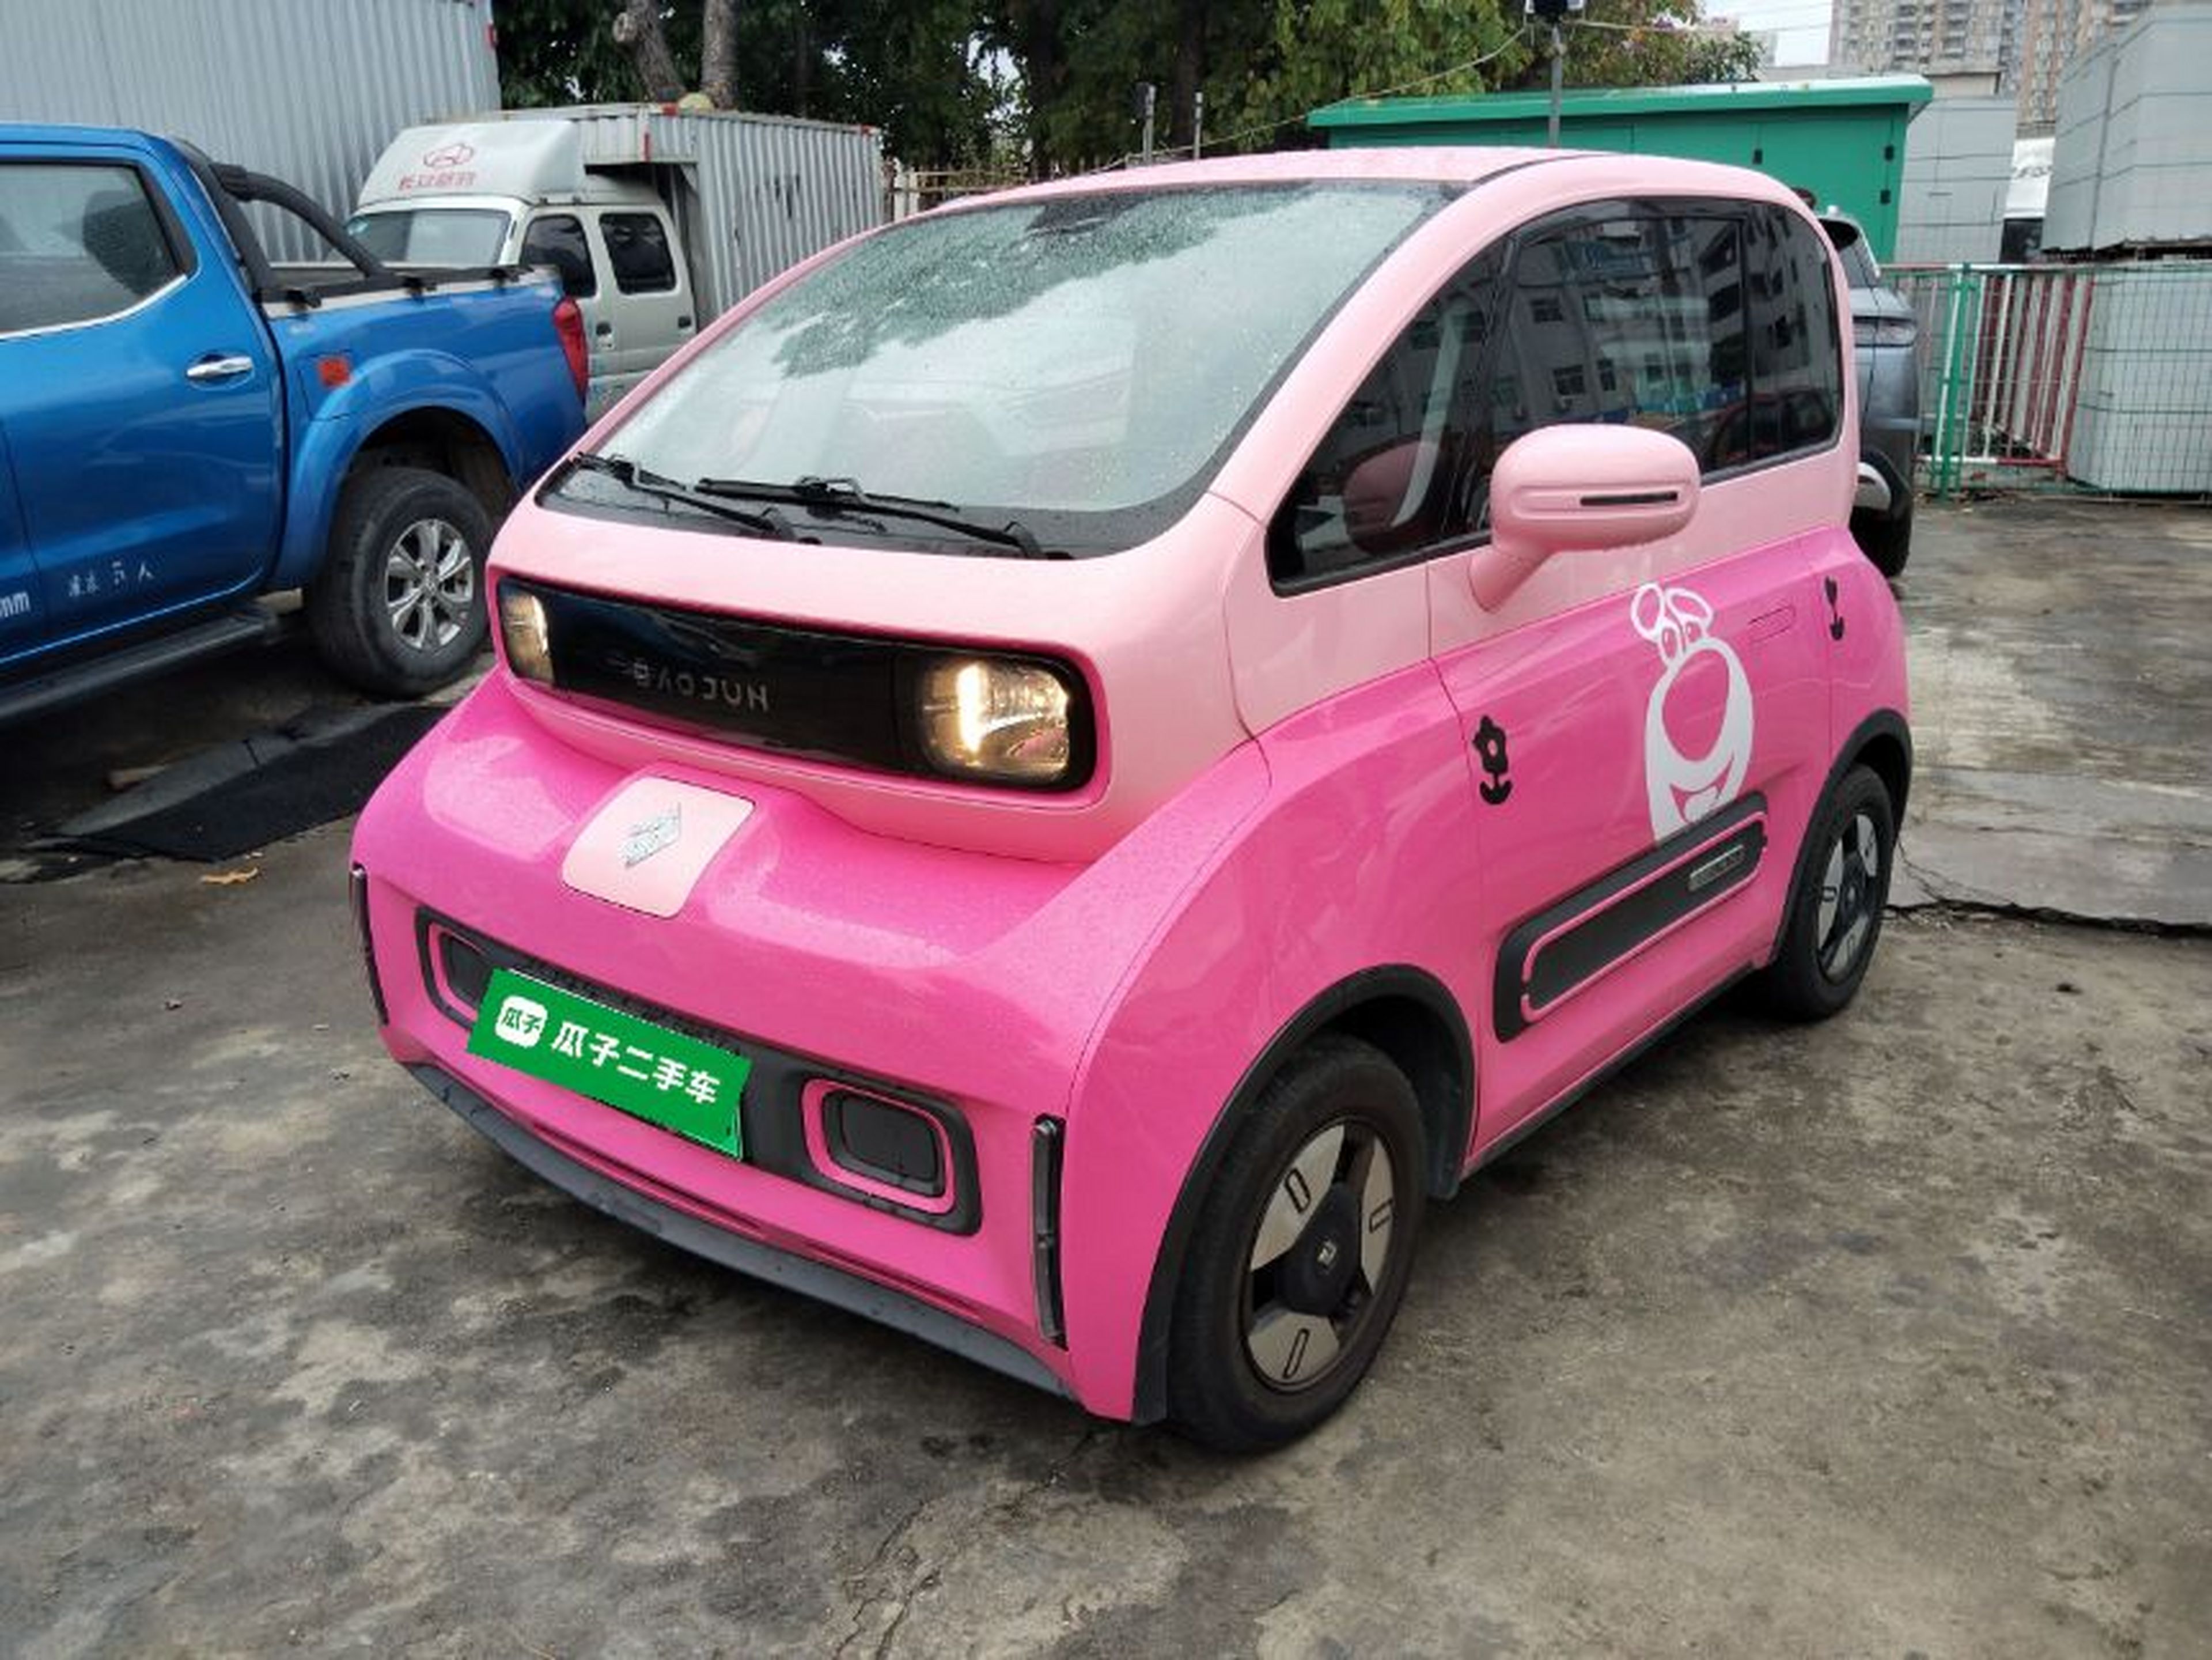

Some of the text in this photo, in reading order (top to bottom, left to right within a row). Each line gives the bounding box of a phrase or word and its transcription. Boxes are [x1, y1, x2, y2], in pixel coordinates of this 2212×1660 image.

[633, 661, 769, 712] BAOJUN
[501, 1007, 543, 1035] 瓜子
[551, 1021, 721, 1105] 瓜子二手车
